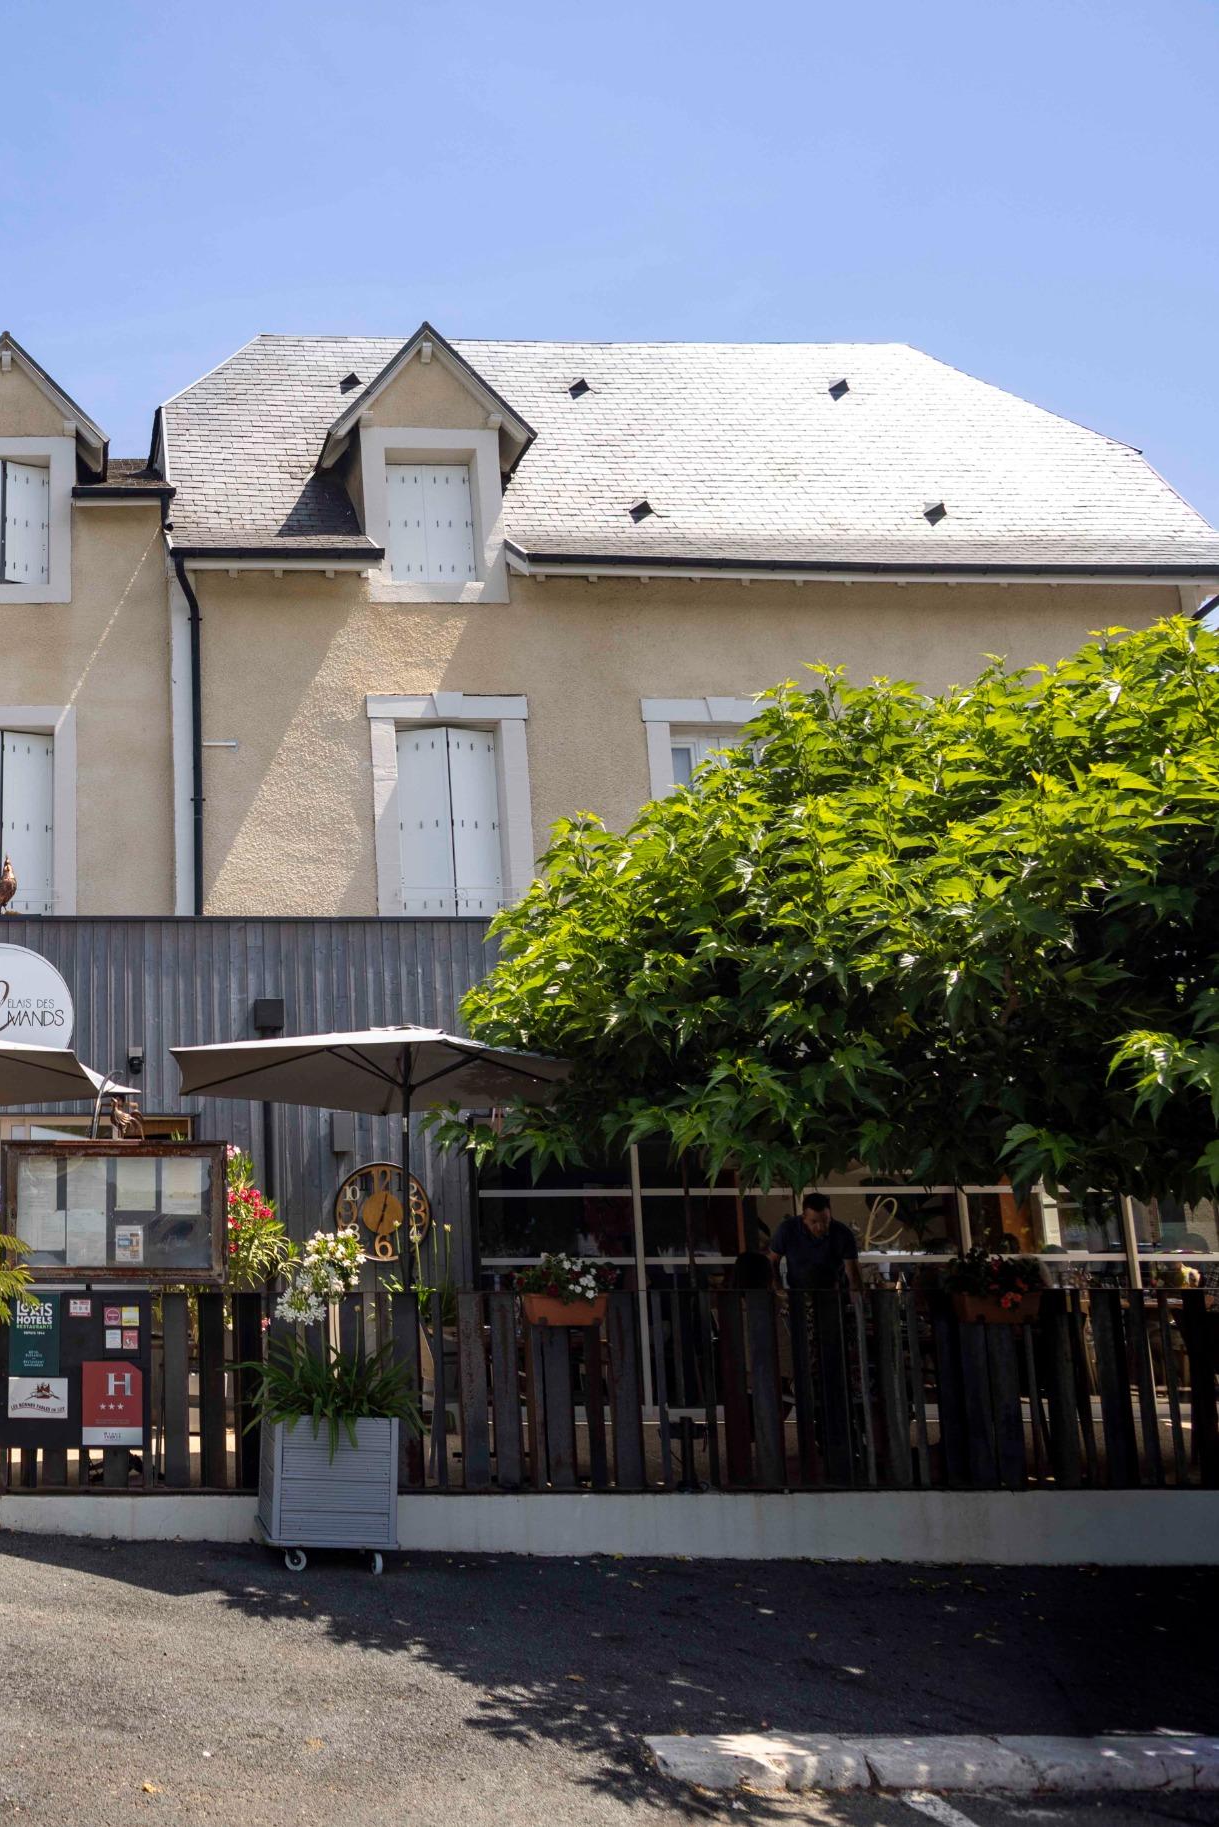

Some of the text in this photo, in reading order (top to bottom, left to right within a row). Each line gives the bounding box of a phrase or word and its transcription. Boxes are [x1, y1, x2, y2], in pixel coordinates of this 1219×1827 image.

[36, 999, 55, 1009] DES
[371, 1168, 391, 1192] 12
[343, 1186, 360, 1201] 10
[374, 1234, 393, 1258] 6
[16, 1316, 53, 1325] HOTELS
[106, 1373, 134, 1396] H
